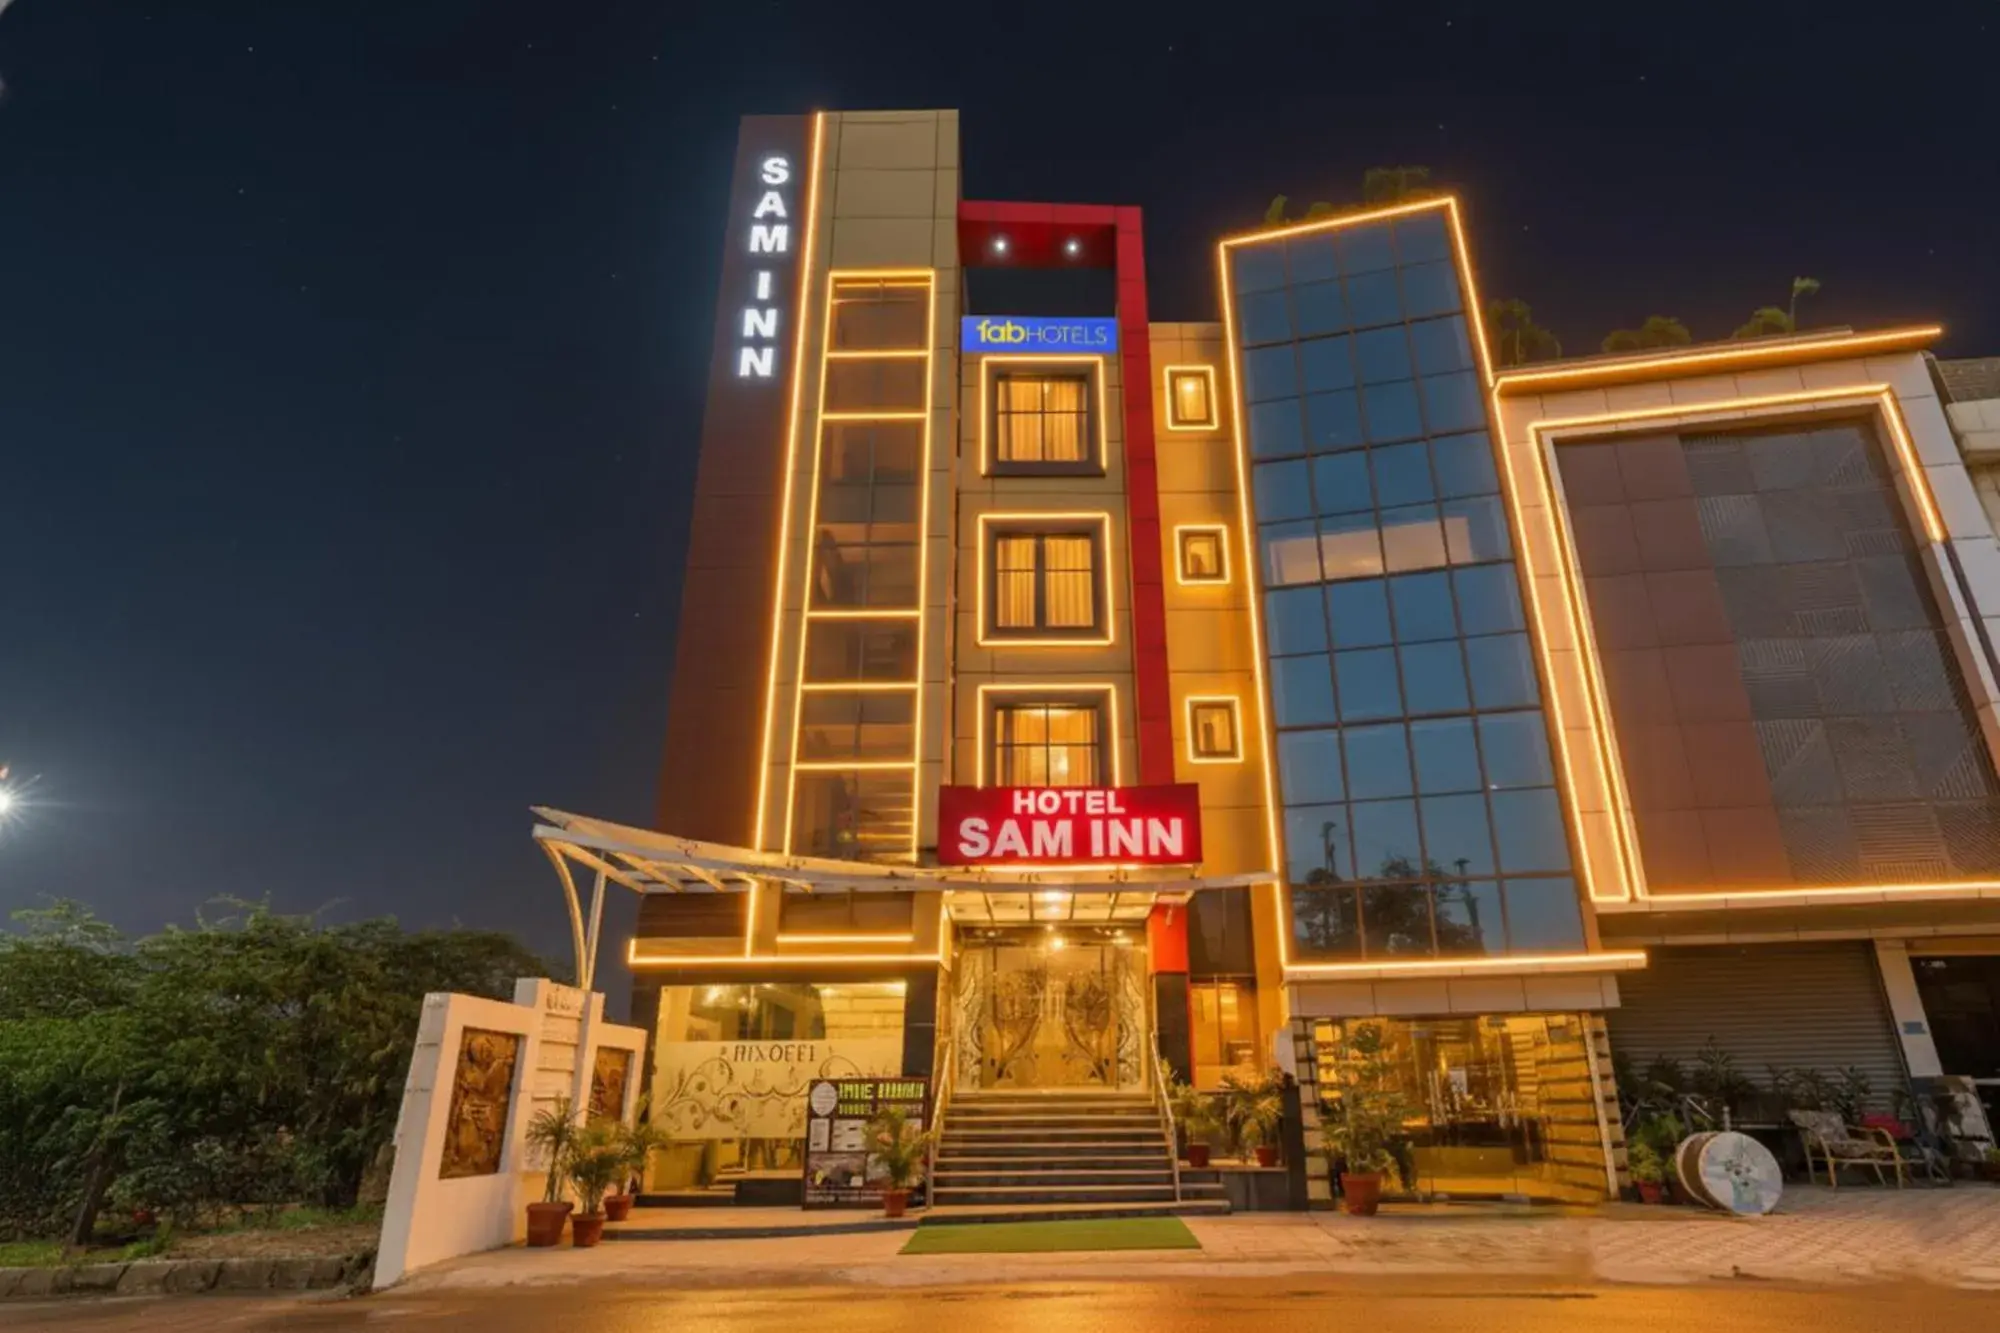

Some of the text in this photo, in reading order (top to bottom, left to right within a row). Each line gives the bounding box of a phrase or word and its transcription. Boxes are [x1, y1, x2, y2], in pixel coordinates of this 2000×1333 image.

[739, 157, 790, 377] SAM INN
[976, 319, 1107, 345] fabHOTELS
[1012, 790, 1126, 815] HOTEL
[958, 817, 1184, 858] SAM INN
